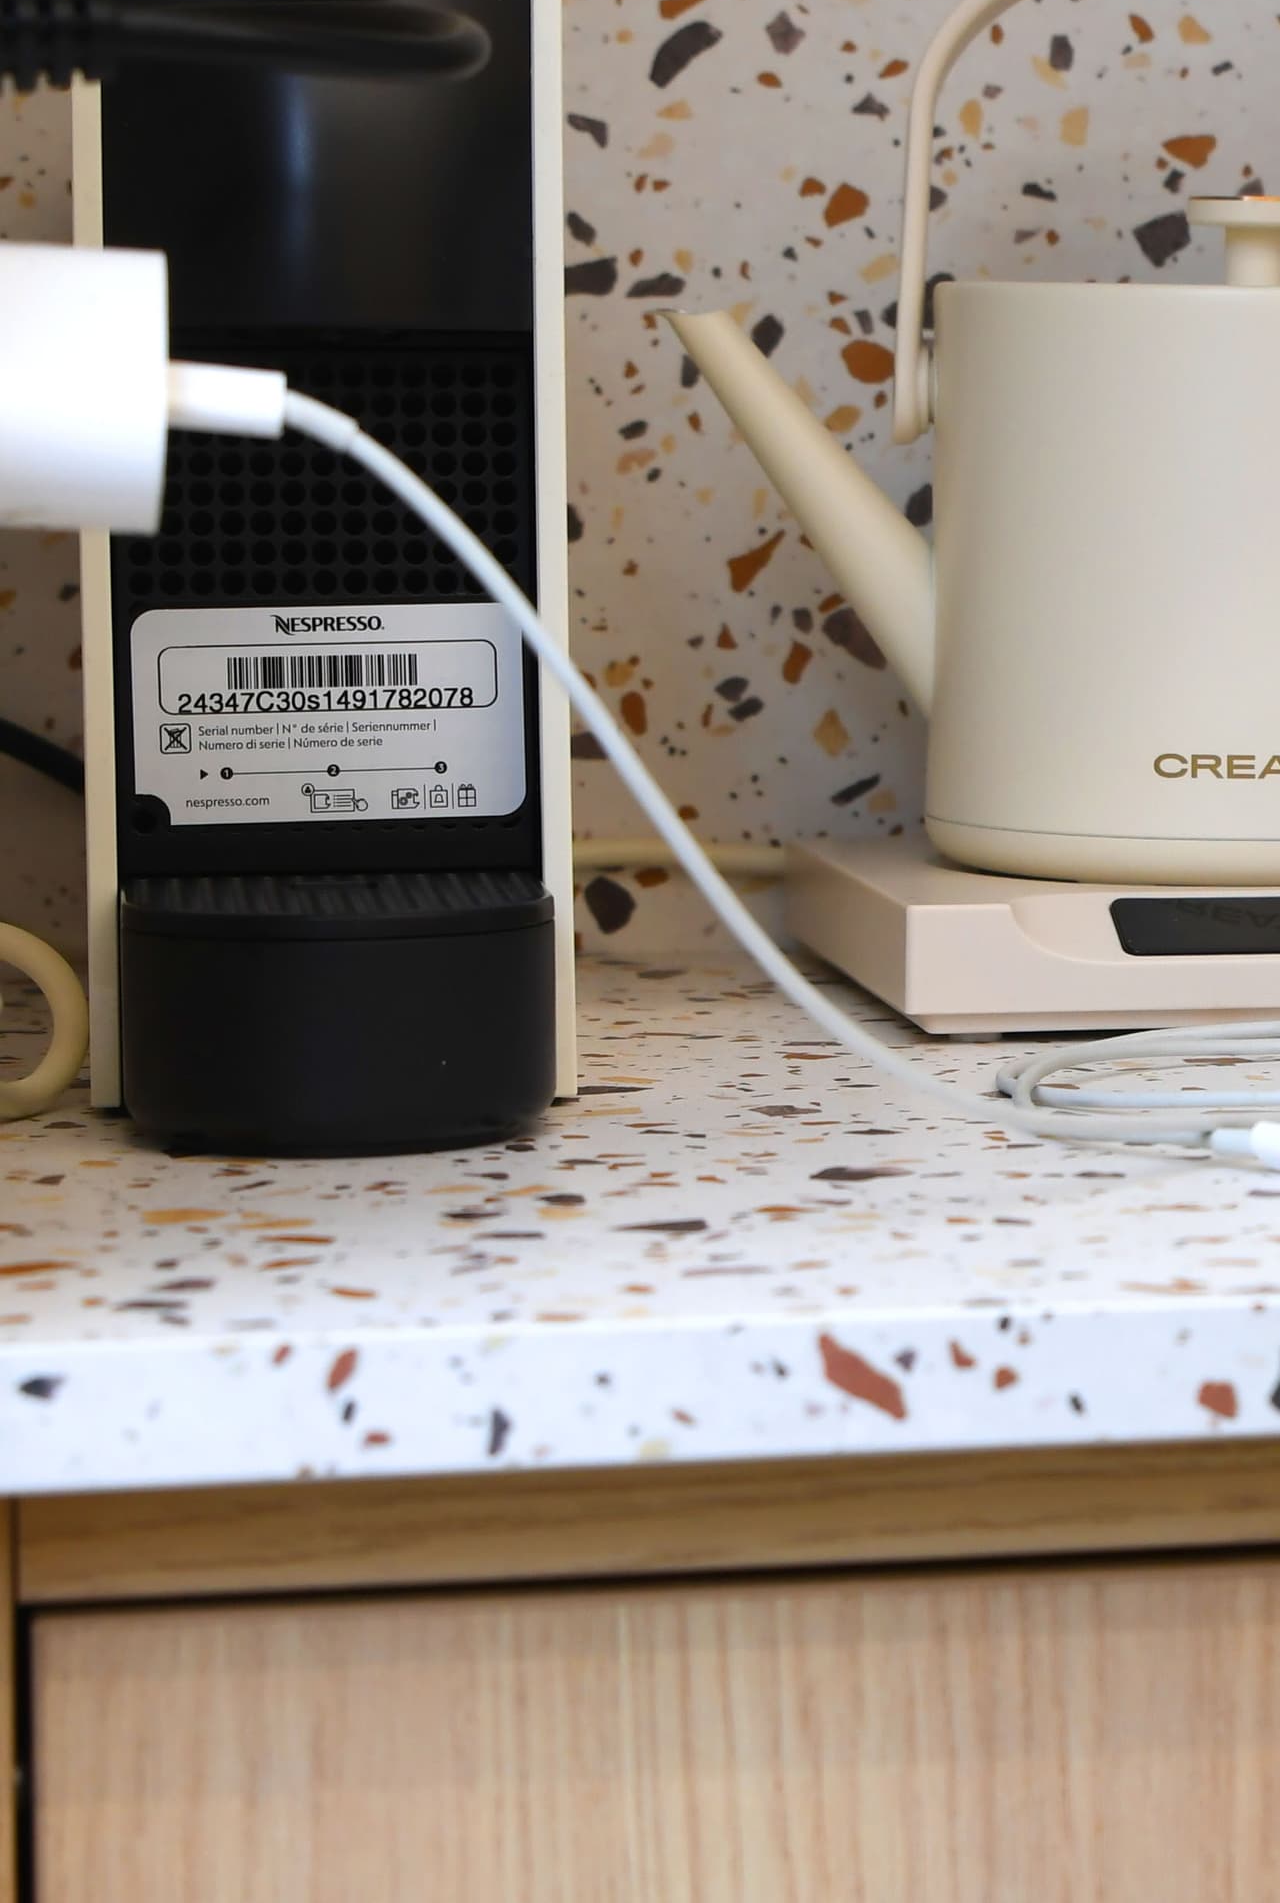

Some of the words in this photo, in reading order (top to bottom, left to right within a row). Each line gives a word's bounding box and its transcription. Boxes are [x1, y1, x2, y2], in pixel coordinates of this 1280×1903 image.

[270, 614, 383, 636] NESPRESSO
[198, 726, 228, 737] Serial
[231, 724, 273, 736] number
[300, 723, 316, 734] de
[318, 720, 344, 733] série
[352, 721, 431, 733] Seriennummer
[198, 740, 244, 751] Numero
[247, 739, 258, 750] di
[259, 738, 286, 749] serie
[293, 736, 338, 748] Número
[340, 736, 355, 747] de
[357, 735, 383, 746] serie
[185, 796, 270, 810] nespresso.com
